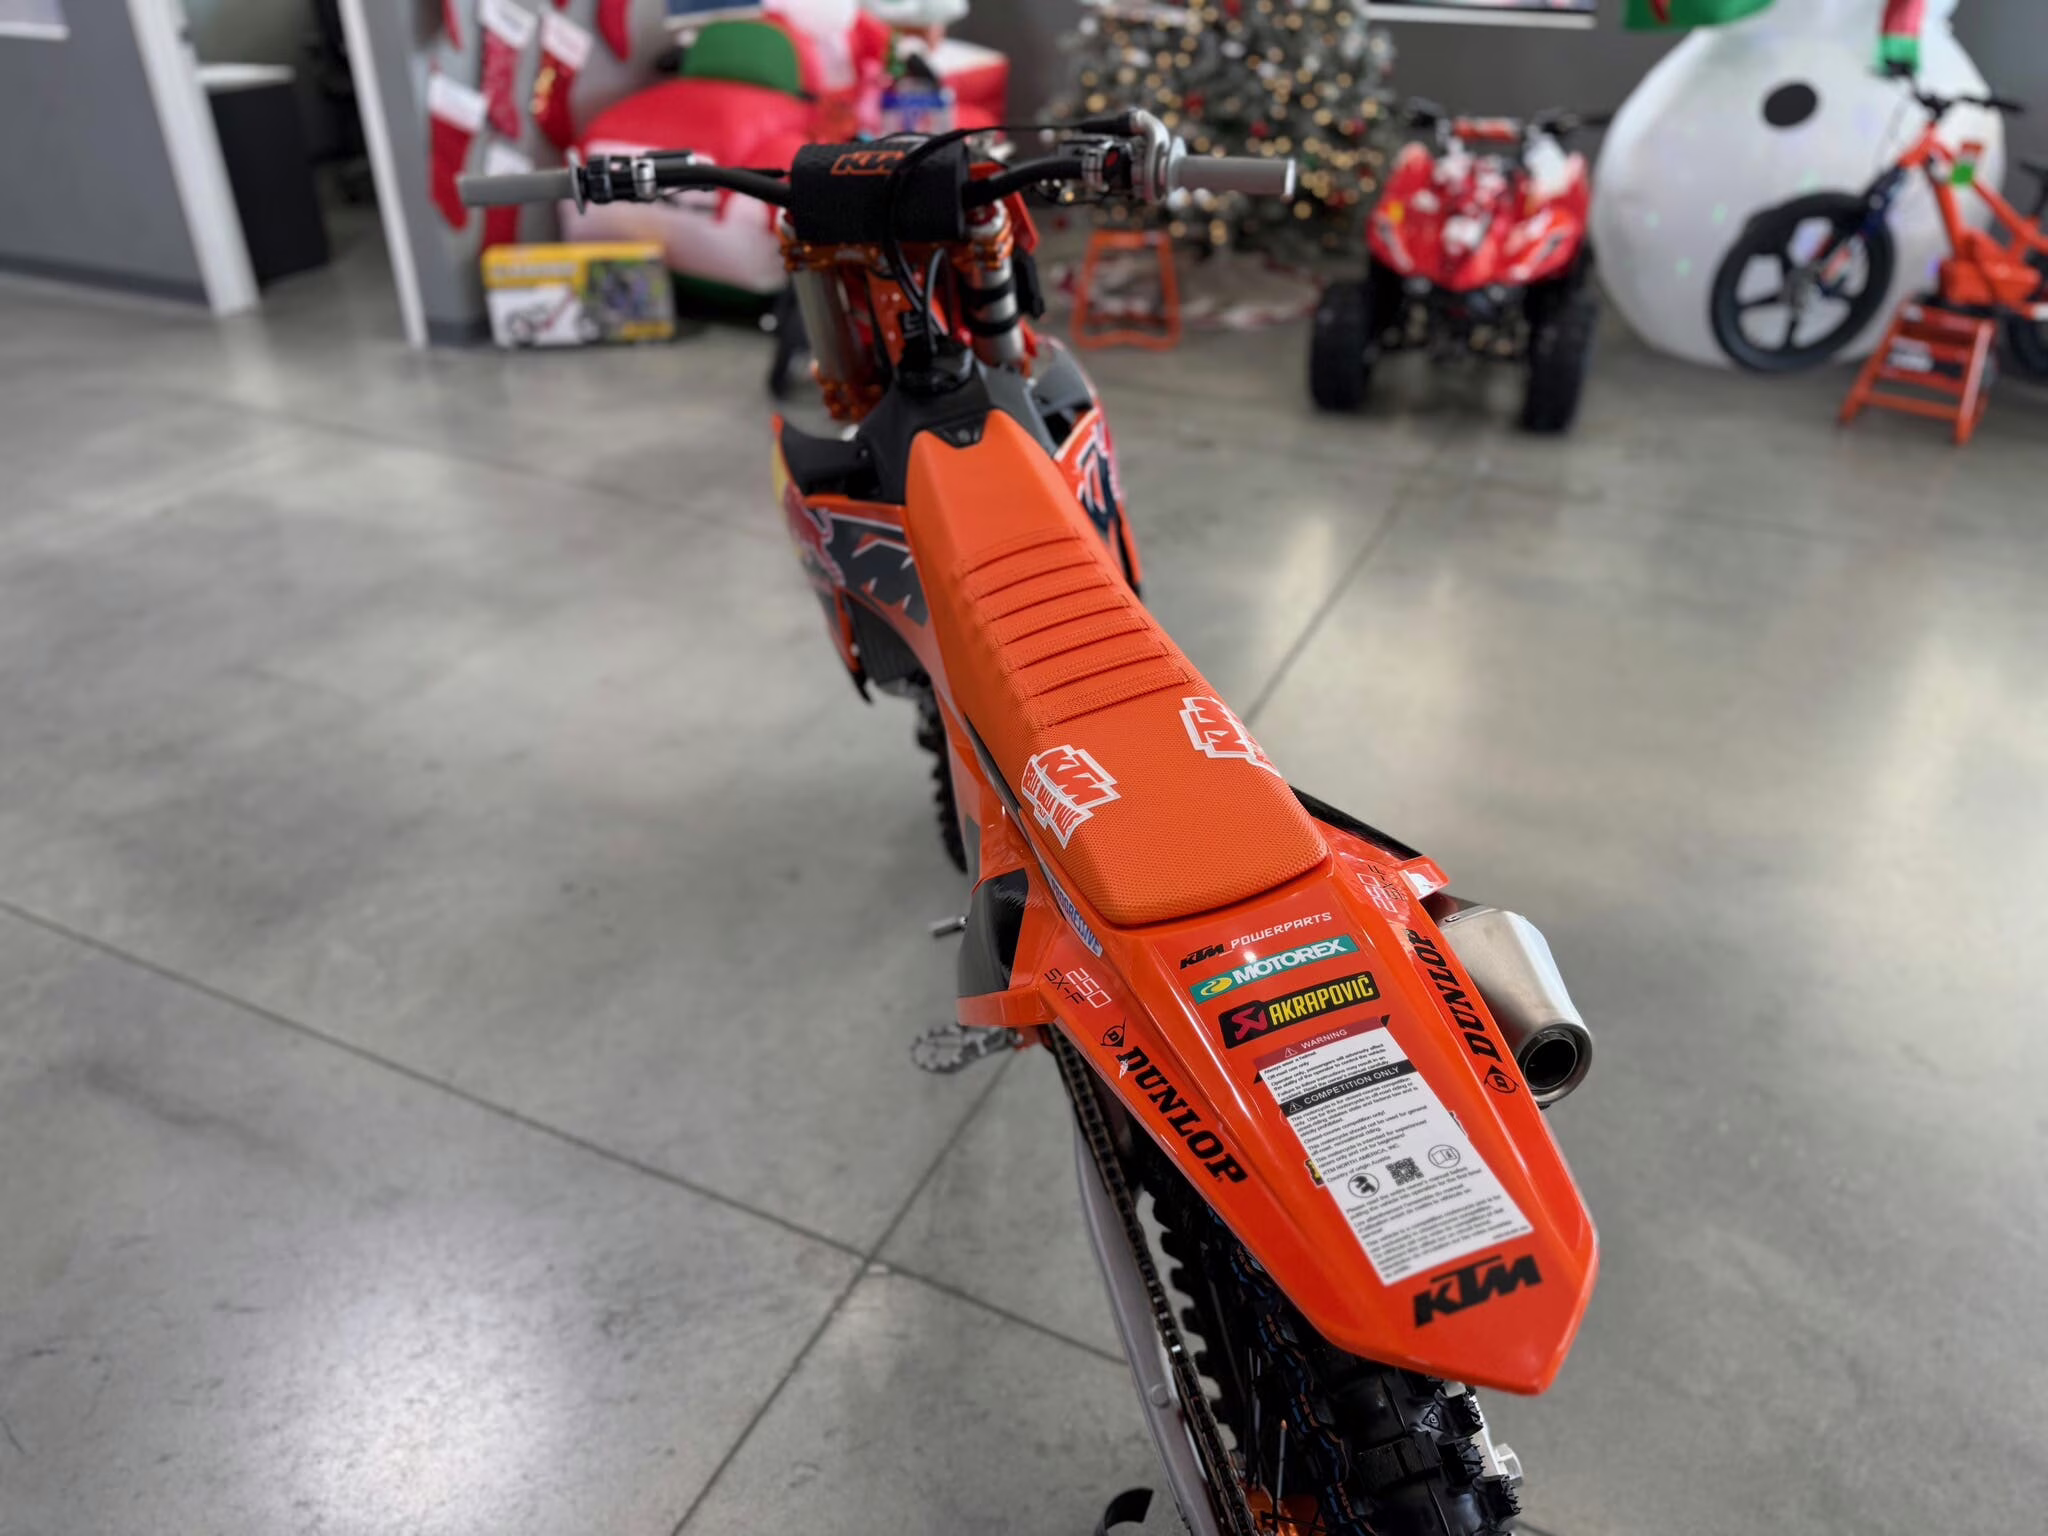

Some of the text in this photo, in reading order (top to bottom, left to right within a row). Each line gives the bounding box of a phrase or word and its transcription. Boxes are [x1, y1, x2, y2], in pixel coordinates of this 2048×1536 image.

[1180, 912, 1332, 970] KTM POWERPARTS
[1232, 938, 1347, 985] MOTOREX
[1044, 967, 1084, 1005] SX-F
[1066, 967, 1112, 1009] 250
[1405, 928, 1503, 1063] DUNLOP
[1301, 1028, 1348, 1049] WARNING
[1303, 1065, 1400, 1105] COMPETITION ONLY
[1115, 1046, 1248, 1183] DUNLOP
[1413, 1254, 1542, 1328] KTM
